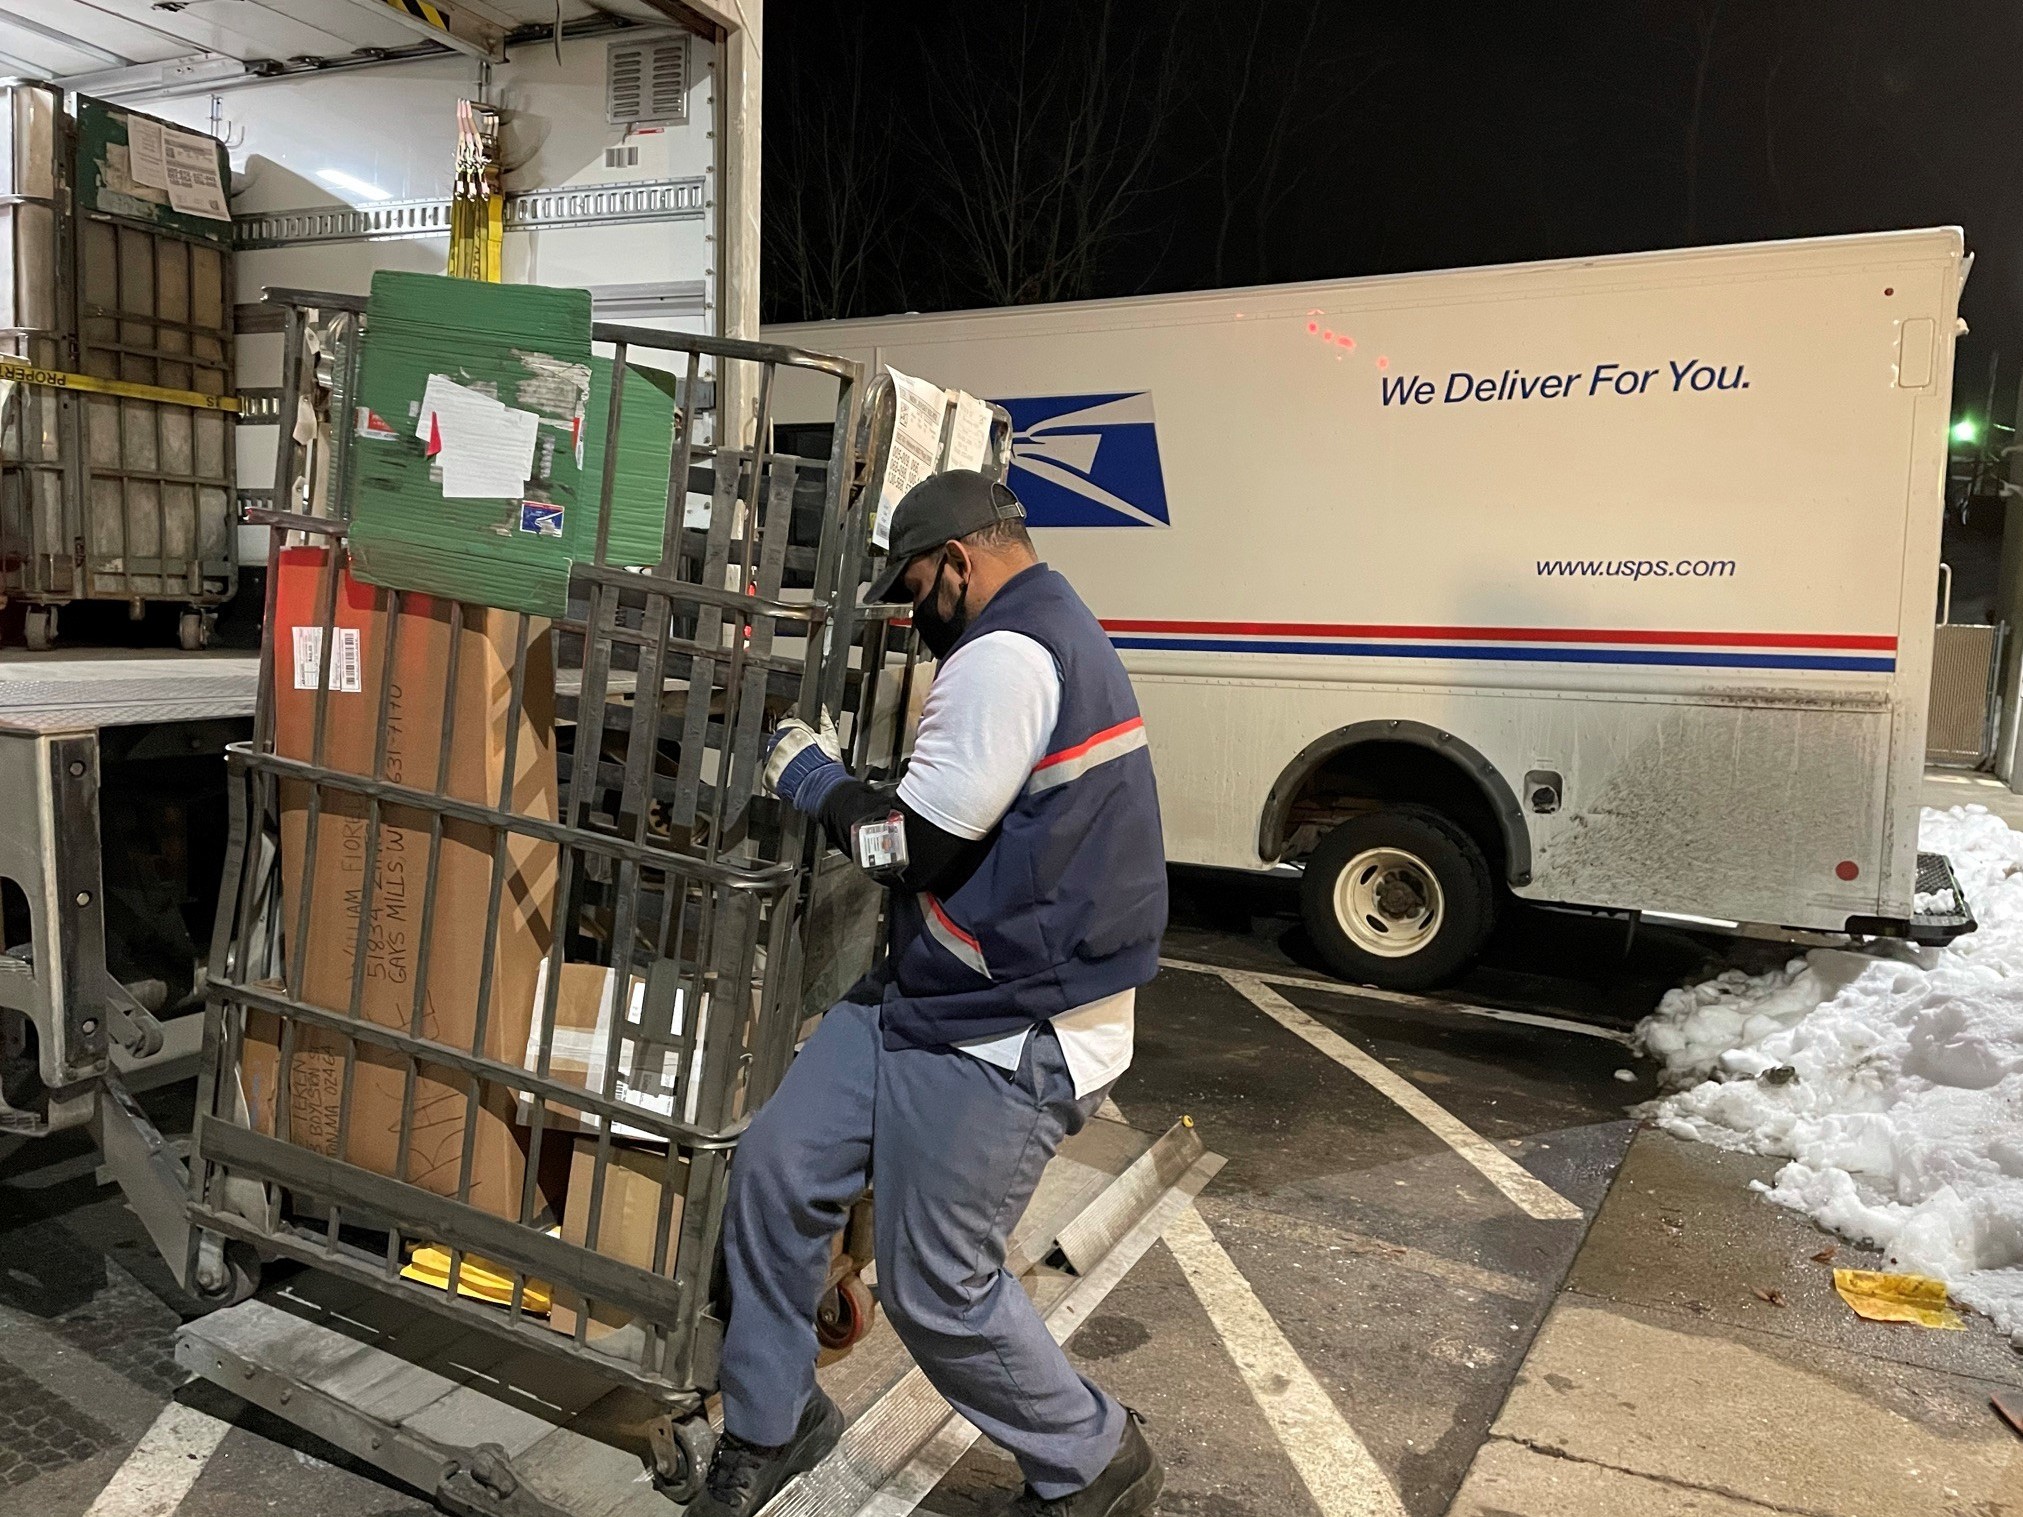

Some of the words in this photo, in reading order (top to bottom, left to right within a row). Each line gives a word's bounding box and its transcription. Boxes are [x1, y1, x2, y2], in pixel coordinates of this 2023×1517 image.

[1381, 375, 1436, 406] We
[1443, 369, 1582, 404] Deliver
[1588, 363, 1660, 396] For
[1669, 359, 1752, 393] You.
[1536, 560, 1736, 581] www.usps.com
[367, 908, 387, 980] 51834
[386, 931, 408, 984] GAYS
